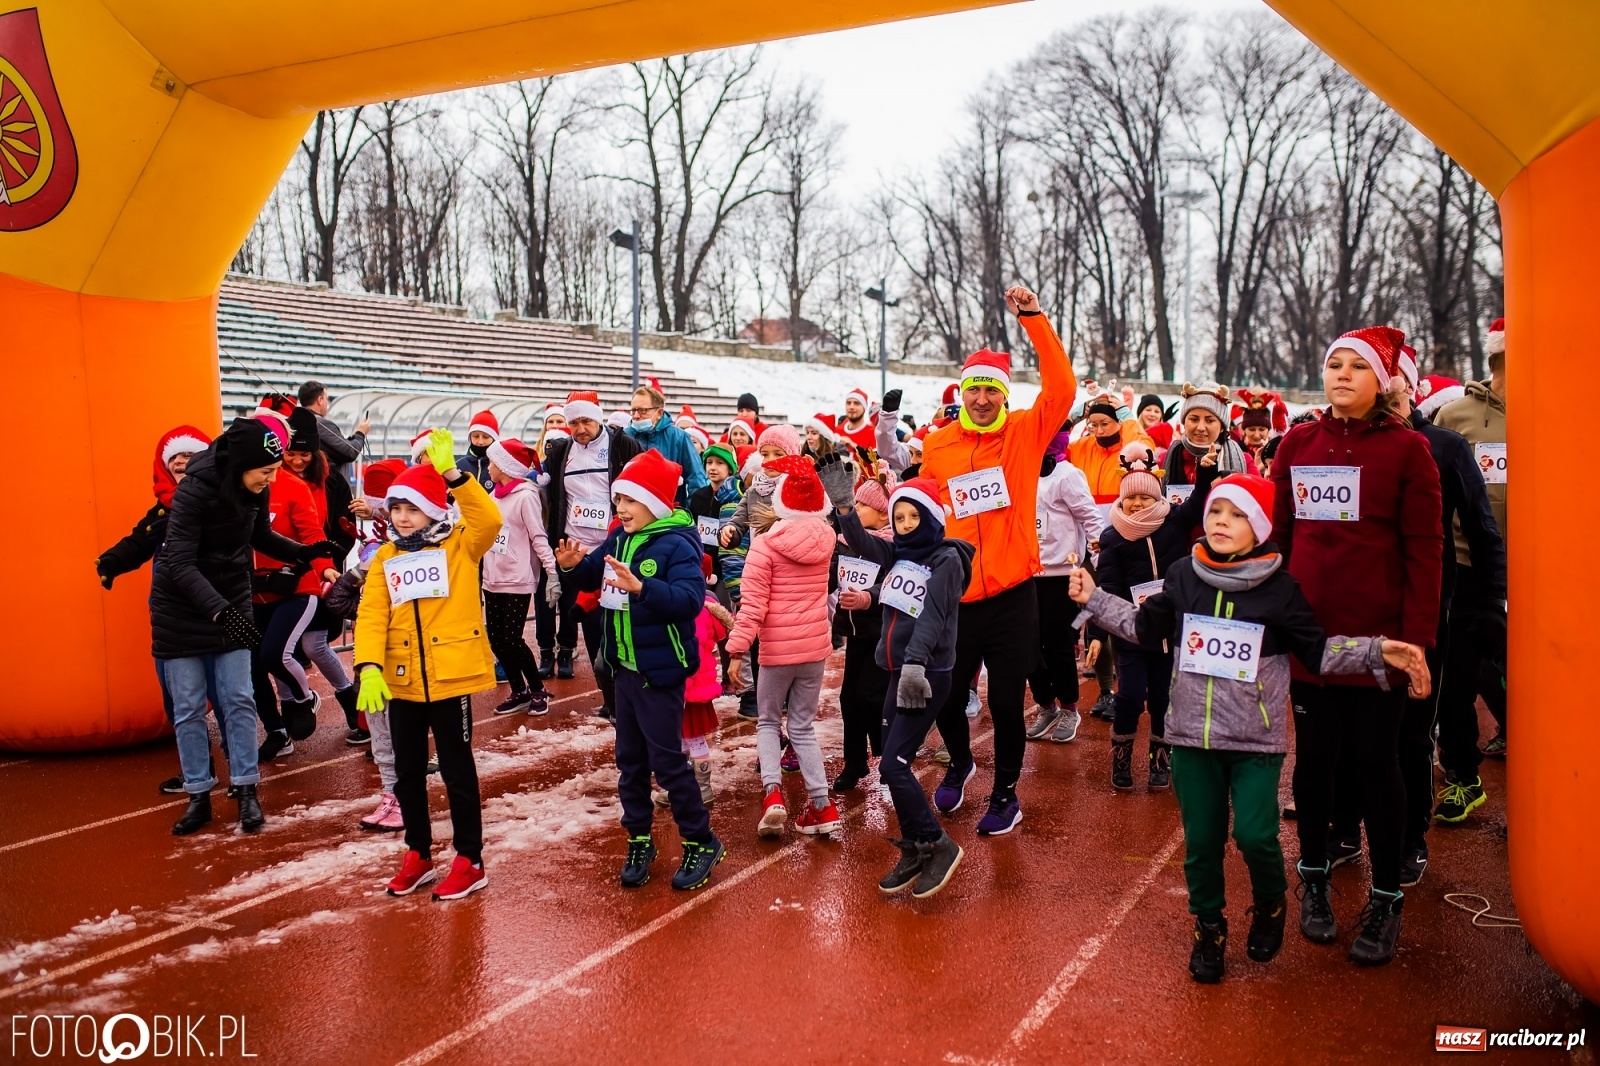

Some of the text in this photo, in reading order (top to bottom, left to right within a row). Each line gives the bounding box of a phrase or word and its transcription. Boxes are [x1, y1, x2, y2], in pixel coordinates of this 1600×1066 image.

[969, 481, 1003, 501] 052
[1310, 485, 1351, 503] 040
[582, 508, 605, 519] 069
[403, 566, 440, 586] 008
[846, 569, 869, 585] 185
[890, 575, 926, 602] 002
[1206, 638, 1252, 661] 038
